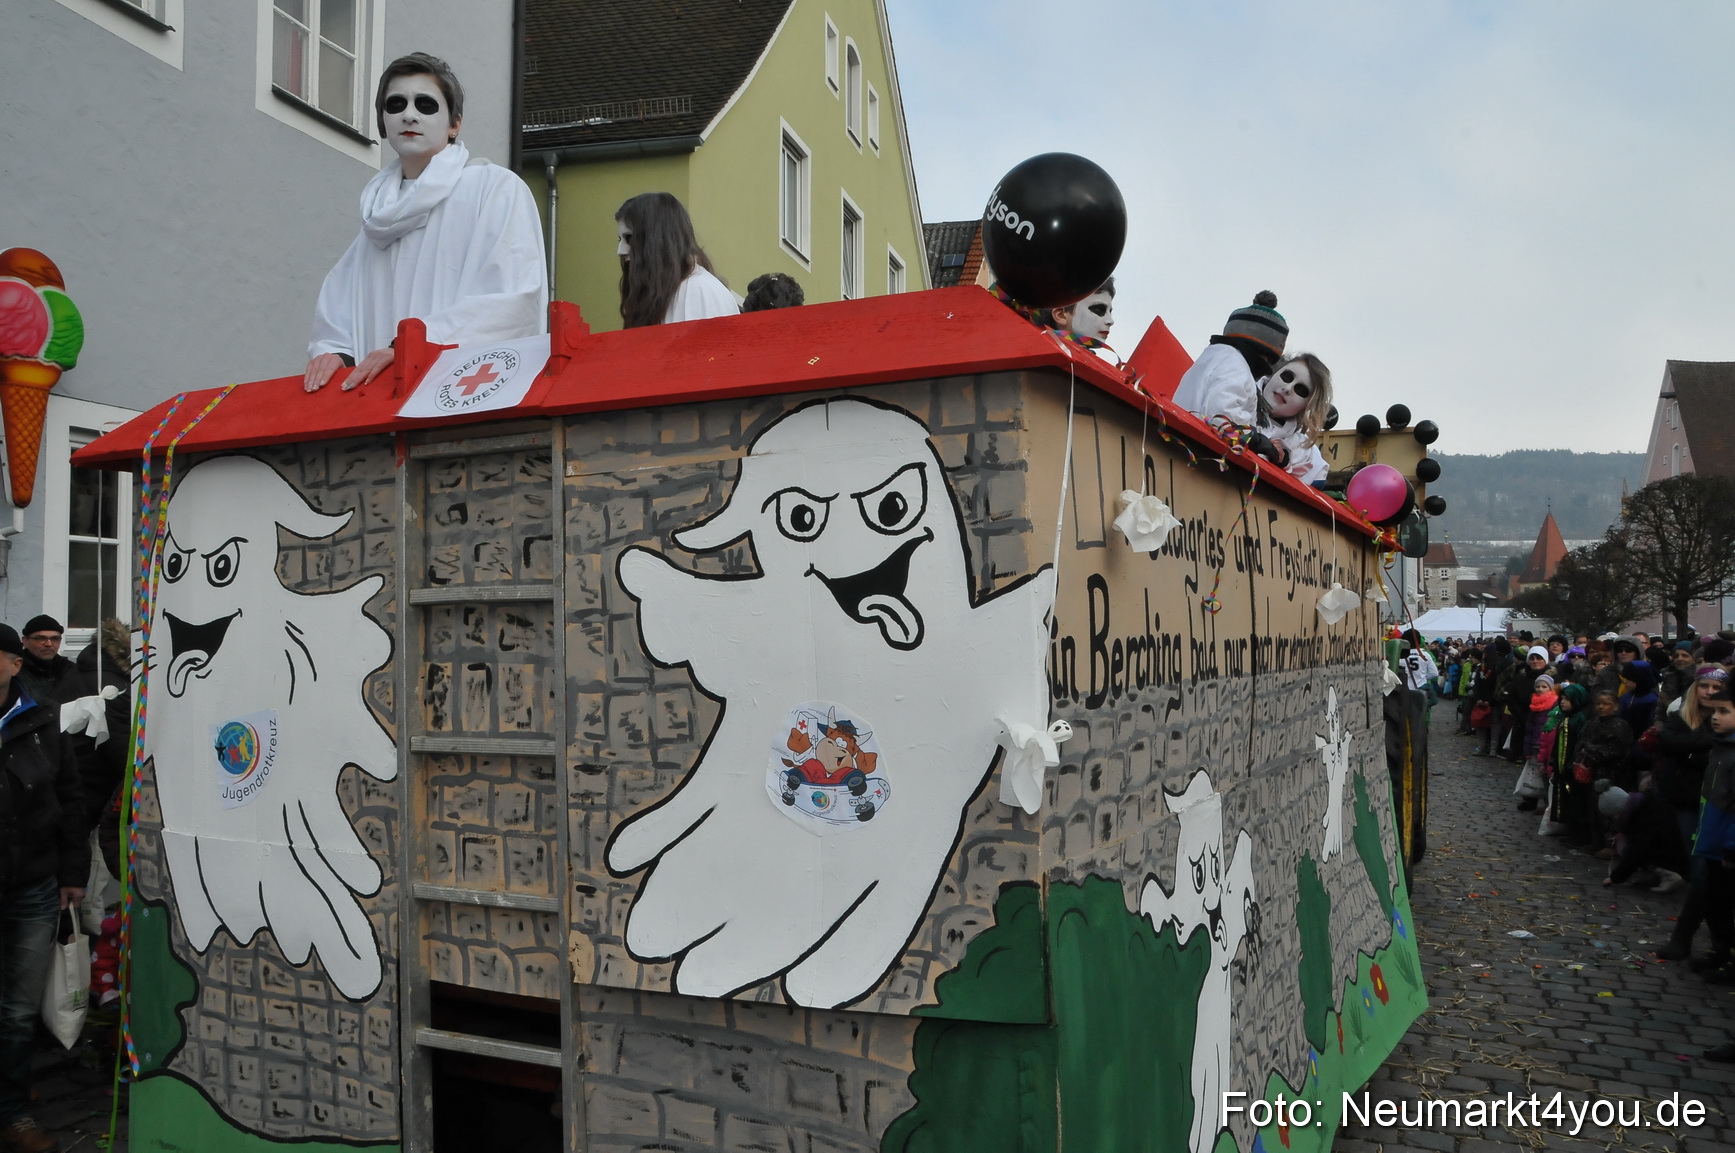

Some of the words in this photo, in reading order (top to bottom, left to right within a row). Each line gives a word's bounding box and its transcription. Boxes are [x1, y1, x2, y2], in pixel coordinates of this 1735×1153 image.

[439, 384, 459, 408] ROTES
[461, 376, 509, 407] KREUZ
[453, 351, 516, 377] DEUTSCHES
[1085, 573, 1183, 722] Berching
[1224, 638, 1247, 680] nur
[222, 718, 278, 802] Jugendrotkreuz
